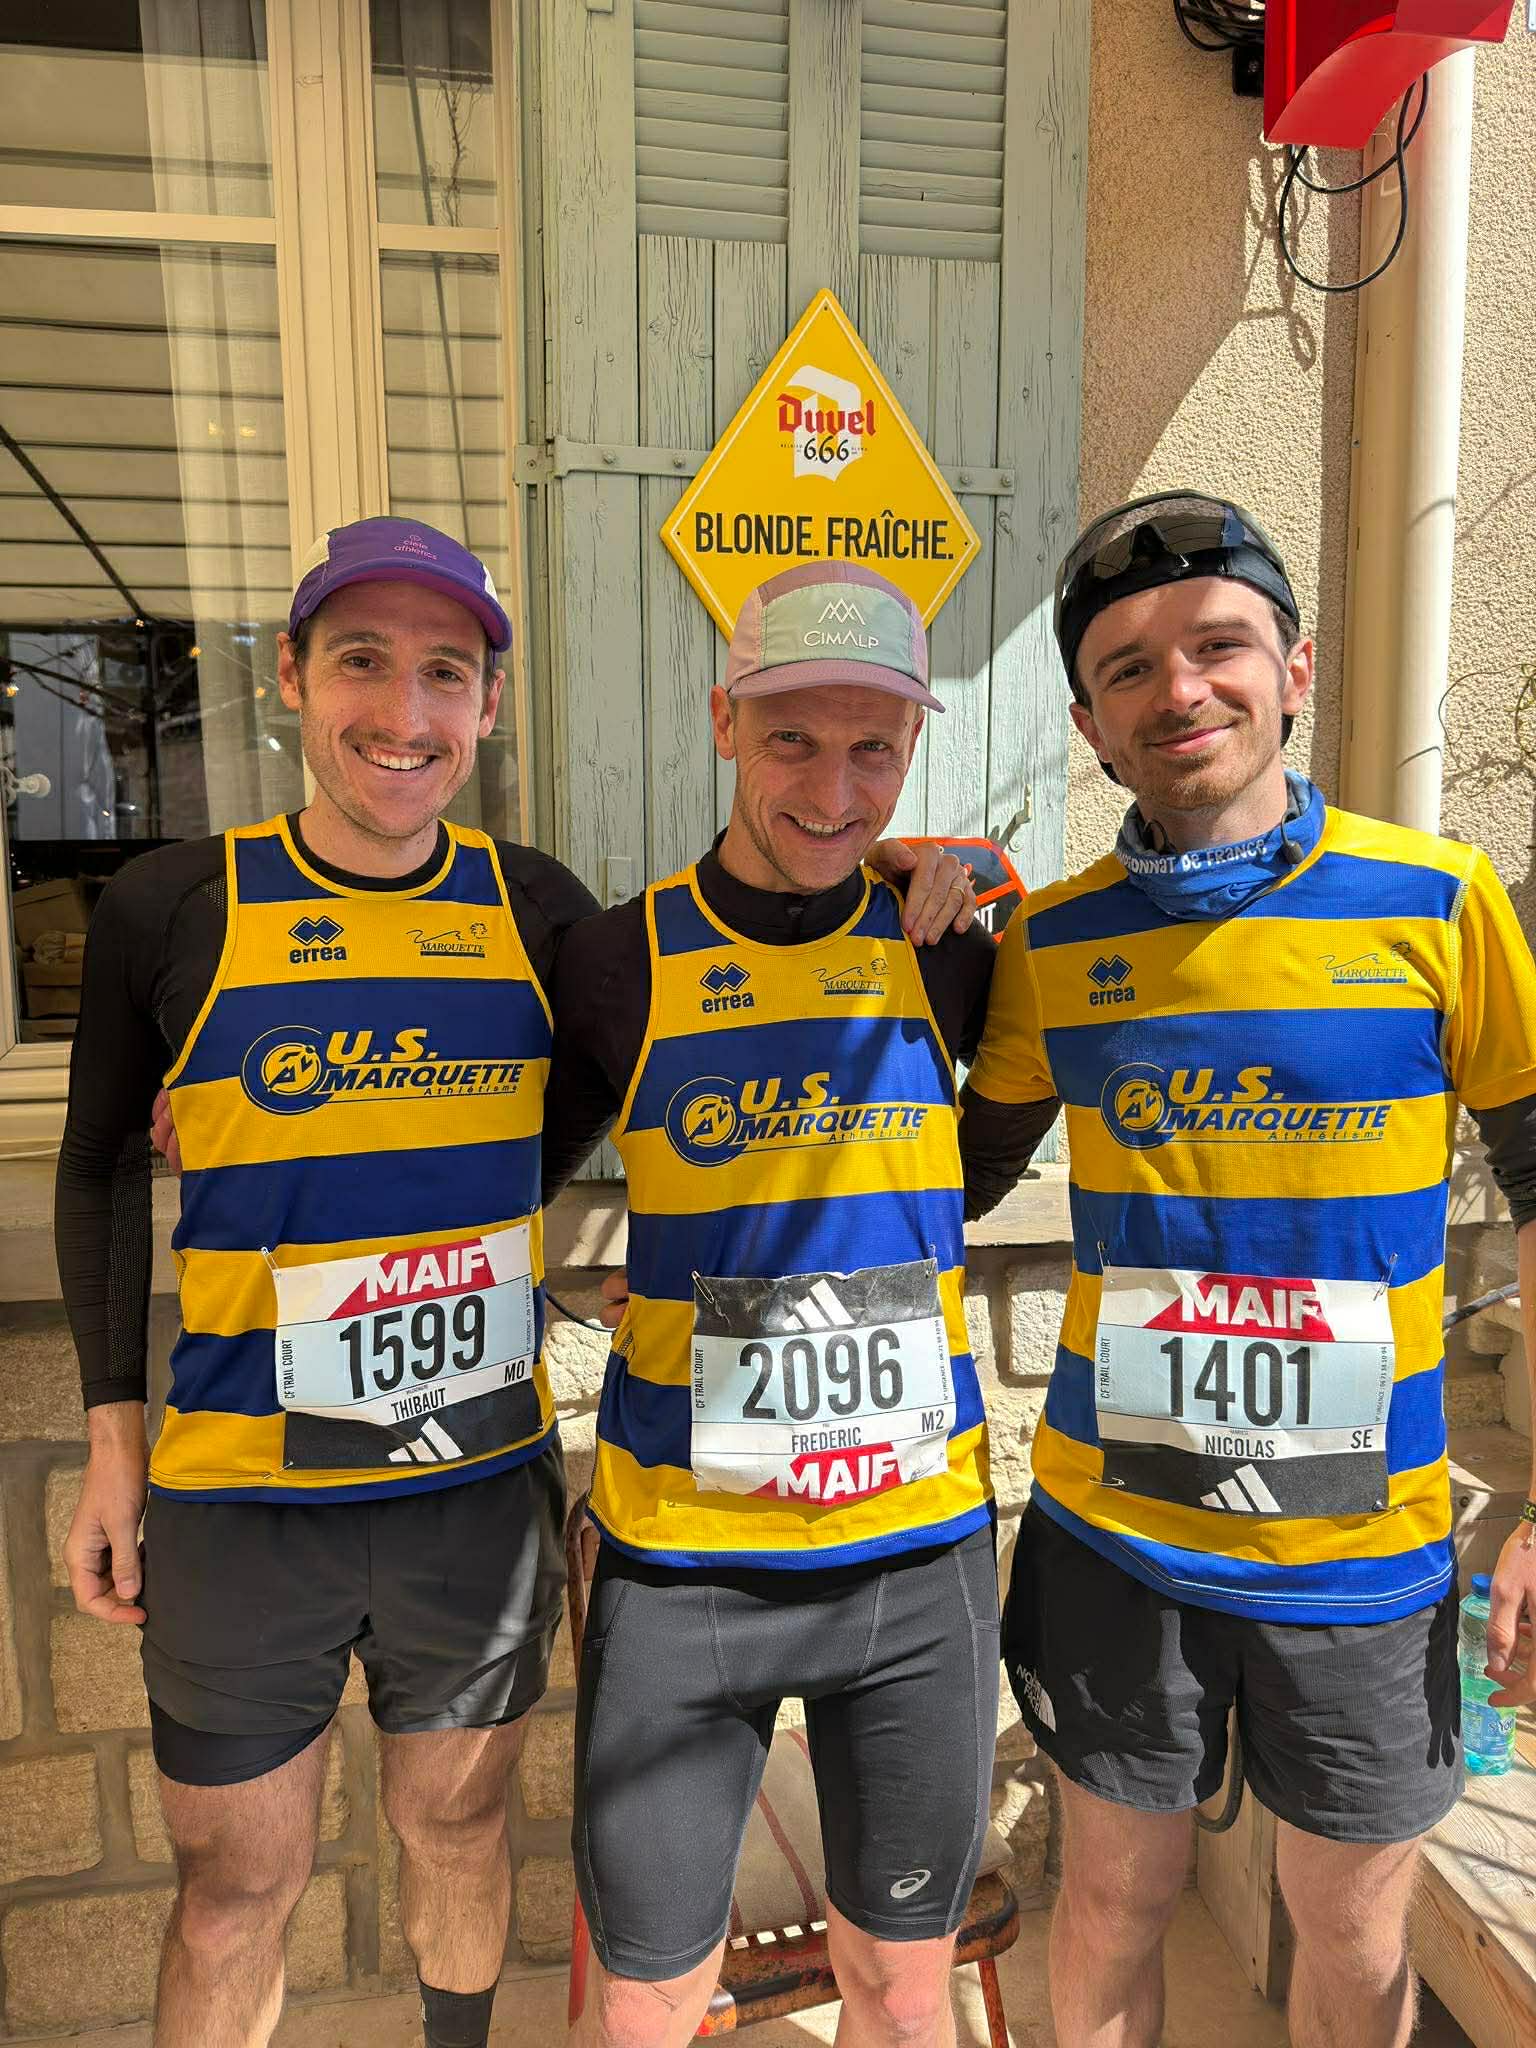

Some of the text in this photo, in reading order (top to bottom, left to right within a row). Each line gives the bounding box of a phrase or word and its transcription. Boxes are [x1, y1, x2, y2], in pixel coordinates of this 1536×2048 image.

[776, 393, 876, 437] Duvel
[695, 509, 954, 560] BLONDE. FRAÎCHE.
[803, 630, 879, 649] CIMALP
[289, 945, 347, 964] errea
[420, 942, 485, 953] MARQUETTE
[824, 980, 884, 990] MARQUETTE
[1332, 967, 1406, 978] MARQUETTE
[701, 991, 755, 1014] errea
[1088, 984, 1136, 1007] errea
[326, 1028, 439, 1065] U.S.
[320, 1063, 525, 1092] MARQUETTE
[1168, 1066, 1285, 1105] U.S.
[738, 1071, 840, 1115] U.S.
[735, 1106, 929, 1141] MARQUETTE
[1161, 1105, 1392, 1131] MARQUETTE
[364, 1246, 487, 1301] MAIF
[1182, 1284, 1320, 1329] MAIF
[281, 1339, 293, 1366] COURT
[339, 1294, 486, 1400] 1599
[1100, 1337, 1111, 1363] COURT
[694, 1348, 704, 1375] COURT
[739, 1327, 904, 1421] 2096
[283, 1367, 294, 1389] TRAIL
[694, 1376, 705, 1397] TRAIL
[1100, 1365, 1110, 1387] TRAIL
[1160, 1336, 1312, 1427] 1401
[391, 1387, 446, 1421] THIBAUT
[921, 1409, 945, 1433] M2
[792, 1427, 862, 1453] FREDERIC
[1205, 1434, 1275, 1458] NICOLAS
[1350, 1429, 1373, 1449] SE
[776, 1451, 899, 1500] MAIF
